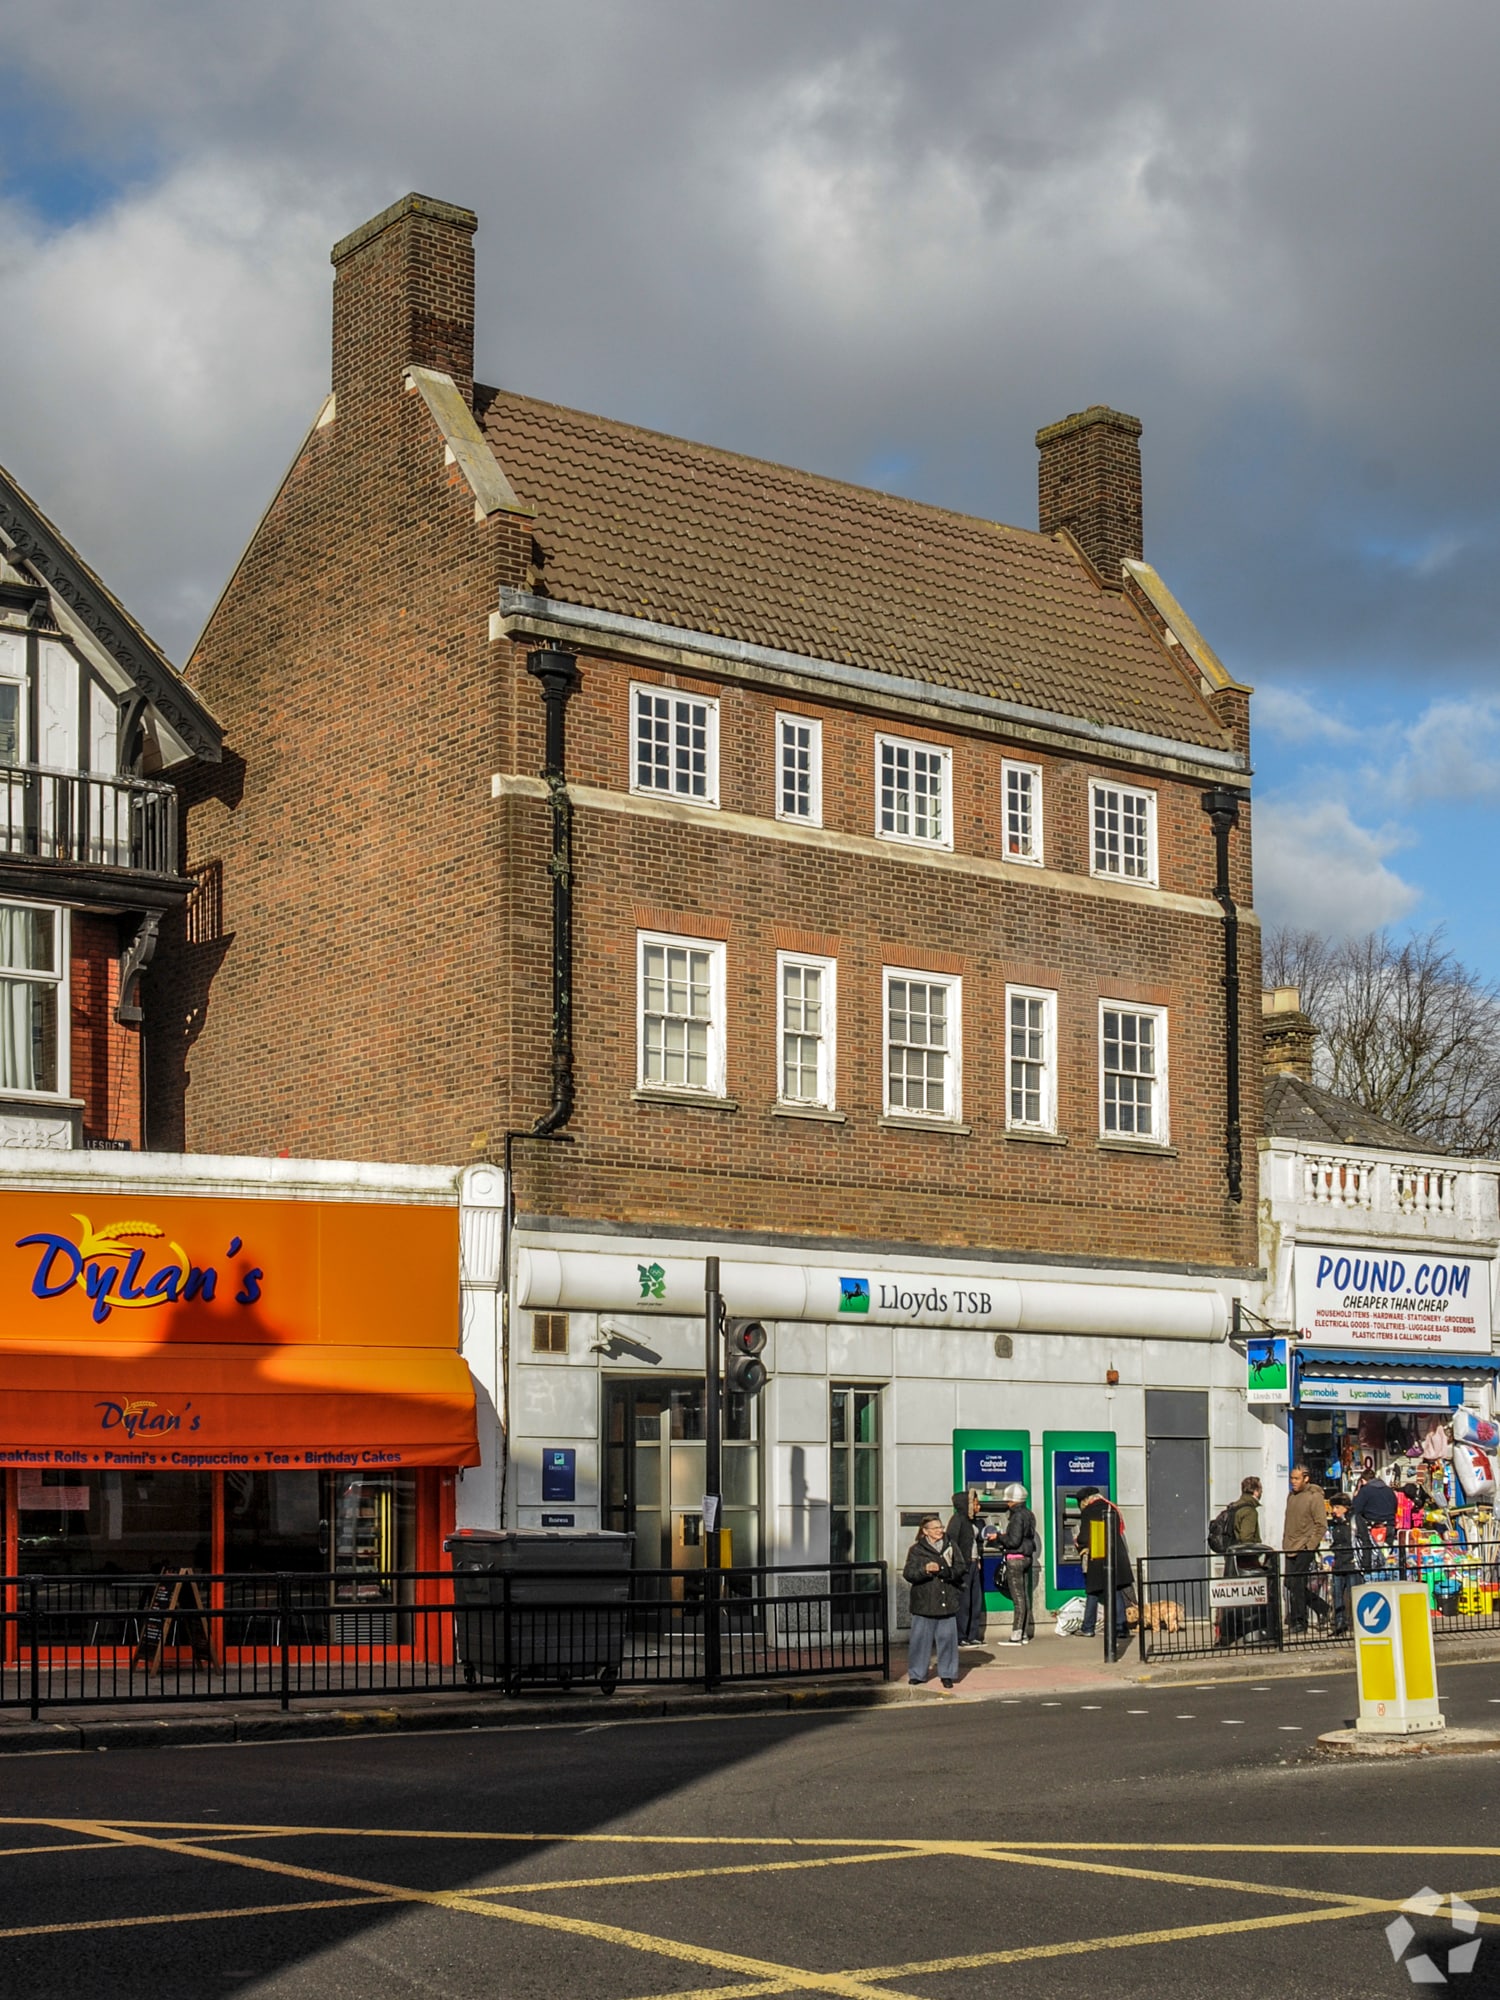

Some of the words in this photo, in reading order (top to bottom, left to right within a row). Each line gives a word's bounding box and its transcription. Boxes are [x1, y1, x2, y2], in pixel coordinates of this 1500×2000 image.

[15, 1233, 263, 1324] Dylan's
[1316, 1255, 1471, 1298] POUND.COM
[879, 1285, 948, 1318] Lloyds
[953, 1291, 992, 1314] TSB
[1343, 1295, 1388, 1310] CHEAPER
[1390, 1297, 1416, 1311] THAN
[1417, 1299, 1449, 1312] CHEAP
[1316, 1309, 1352, 1318] HOUSEHOLD
[1373, 1312, 1404, 1321] HARDWARE
[1407, 1313, 1441, 1322] STATIONERY
[1444, 1315, 1475, 1324] GROCERIES
[1314, 1319, 1350, 1328] ELECTRICAL
[1350, 1321, 1370, 1329] GOODS
[1373, 1322, 1405, 1331] TOILETRIES
[1408, 1324, 1434, 1332] LUGGAGE
[1453, 1326, 1476, 1334] BEDDING
[1352, 1331, 1375, 1339] PLASTIC
[1376, 1332, 1393, 1340] ITEMS
[1399, 1333, 1423, 1341] CALLING
[1423, 1334, 1442, 1342] CARDS
[1300, 1388, 1339, 1398] ycamobile
[1350, 1388, 1391, 1399] Lycamobile
[1402, 1390, 1442, 1400] Lycamobile
[94, 1401, 201, 1439] Dylan's
[54, 1451, 88, 1463] Rolls
[104, 1452, 156, 1464] Panini's
[171, 1452, 249, 1466] Cappuccino
[264, 1452, 289, 1464] Tea
[304, 1452, 358, 1466] Birthday
[362, 1451, 402, 1463] Cakes
[1211, 1587, 1239, 1599] WALM
[1242, 1585, 1266, 1597] LANE
